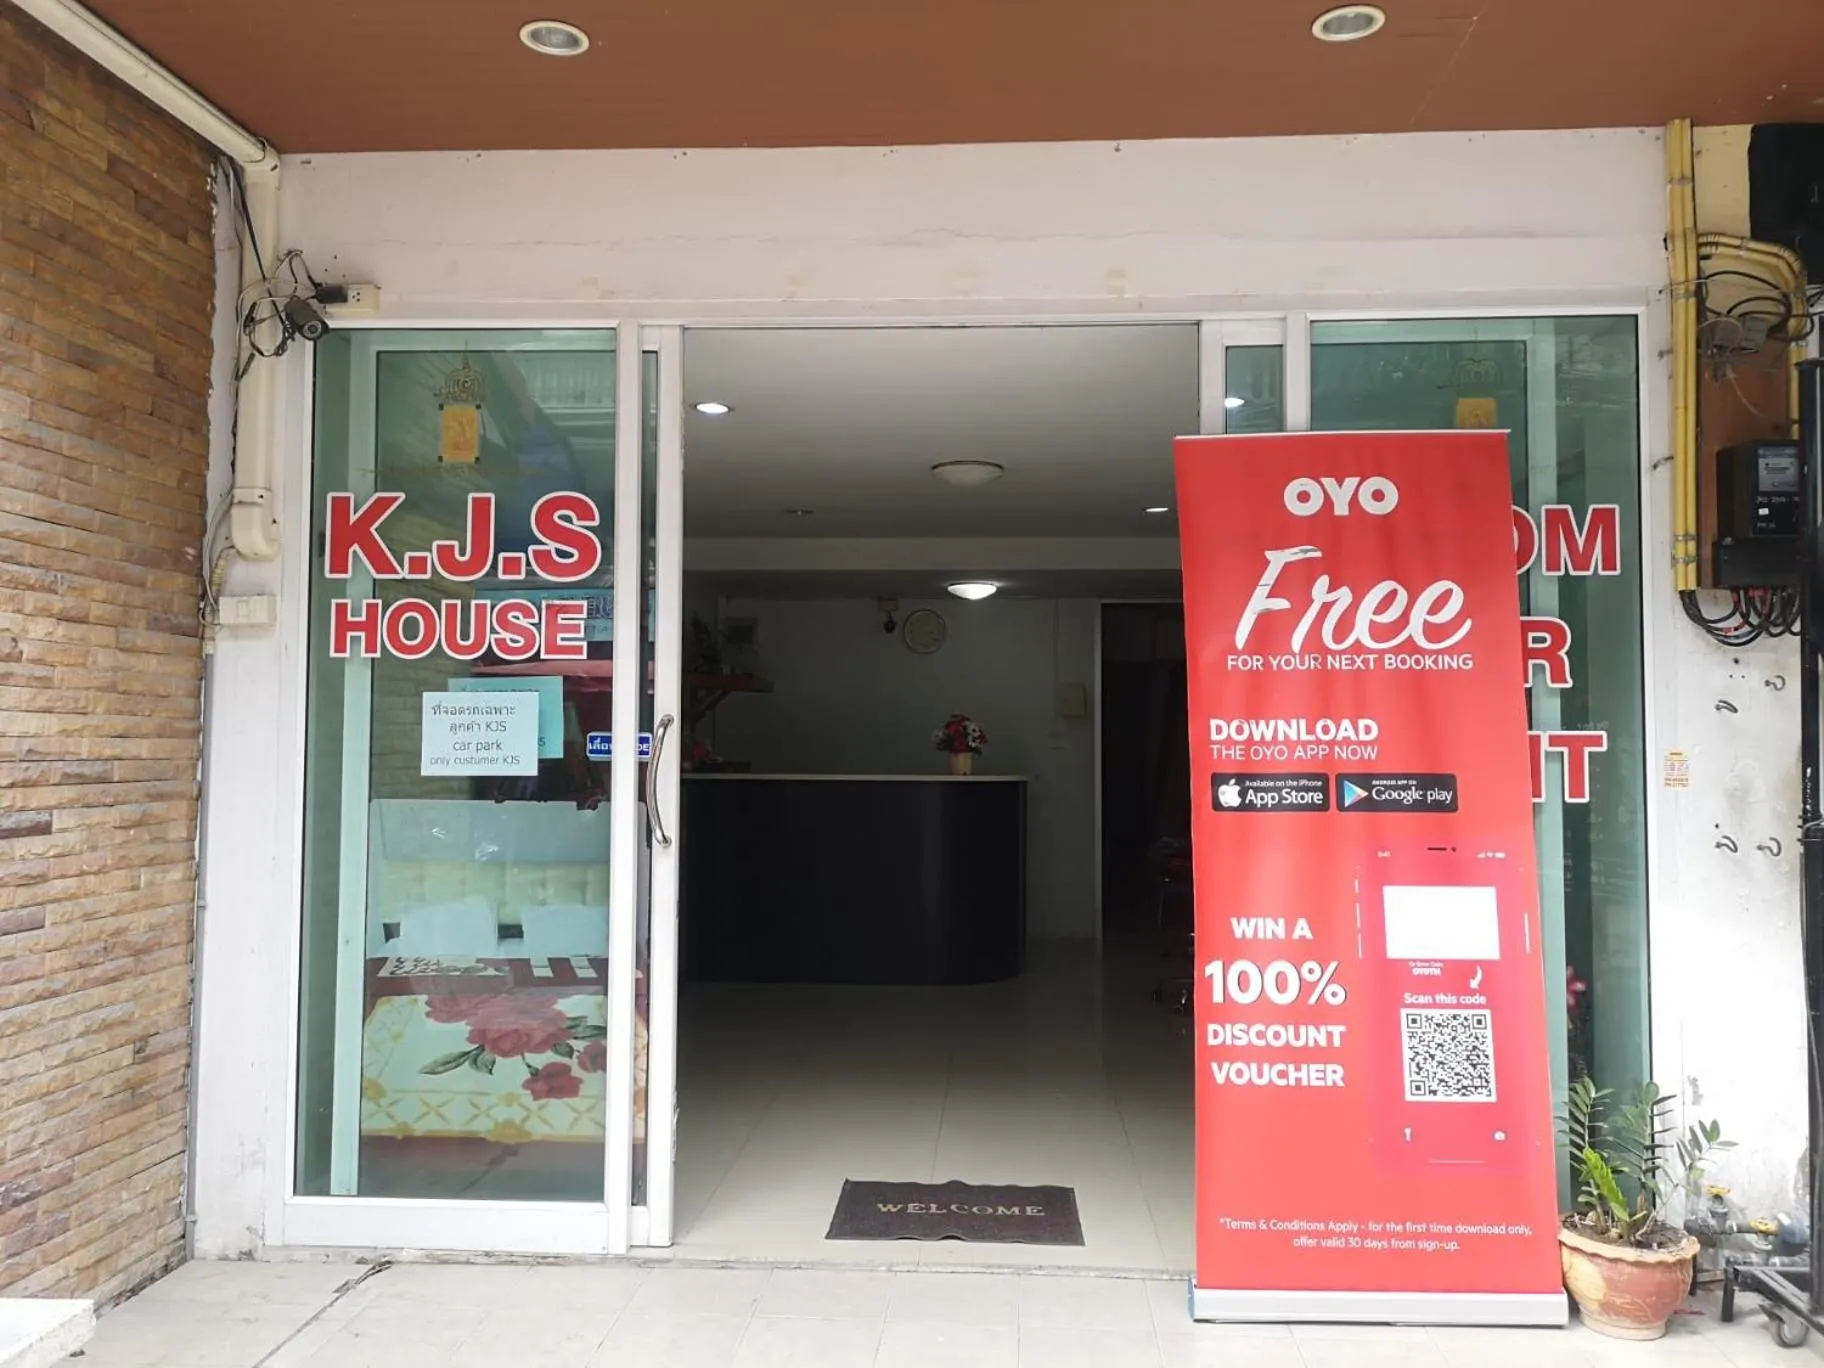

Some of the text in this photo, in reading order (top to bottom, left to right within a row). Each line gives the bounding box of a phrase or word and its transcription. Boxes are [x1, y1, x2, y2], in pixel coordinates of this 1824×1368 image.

[1284, 476, 1399, 516] OYO
[325, 491, 602, 582] K.J.S
[1235, 545, 1472, 653] Free
[329, 598, 588, 660] HOUSE
[1227, 654, 1473, 671] FOR YOUR NEXT BOOKING
[485, 720, 507, 732] KJS
[1209, 718, 1379, 742] DOWNLOAD
[452, 739, 503, 753] car park
[1210, 745, 1378, 761] THE OYO APP NOW
[430, 755, 451, 767] only
[1245, 788, 1323, 808] App Store
[1372, 786, 1453, 805] Google play
[1230, 917, 1314, 939] WIN A
[1204, 959, 1347, 1006] 100%
[1403, 992, 1487, 1005] Scan this code
[1207, 1024, 1346, 1048] DISCOUNT
[1210, 1061, 1345, 1087] VOUCHER
[876, 1203, 1045, 1216] WELCOME
[1259, 1220, 1267, 1230] &
[1270, 1219, 1325, 1231] Conditions
[1328, 1221, 1358, 1233] Apply
[1368, 1221, 1383, 1232] for
[1386, 1221, 1403, 1232] the
[1406, 1221, 1427, 1233] first
[1429, 1222, 1452, 1233] time
[1455, 1222, 1506, 1234] download
[1293, 1236, 1460, 1251] offer valid 30 days from sign-up.
